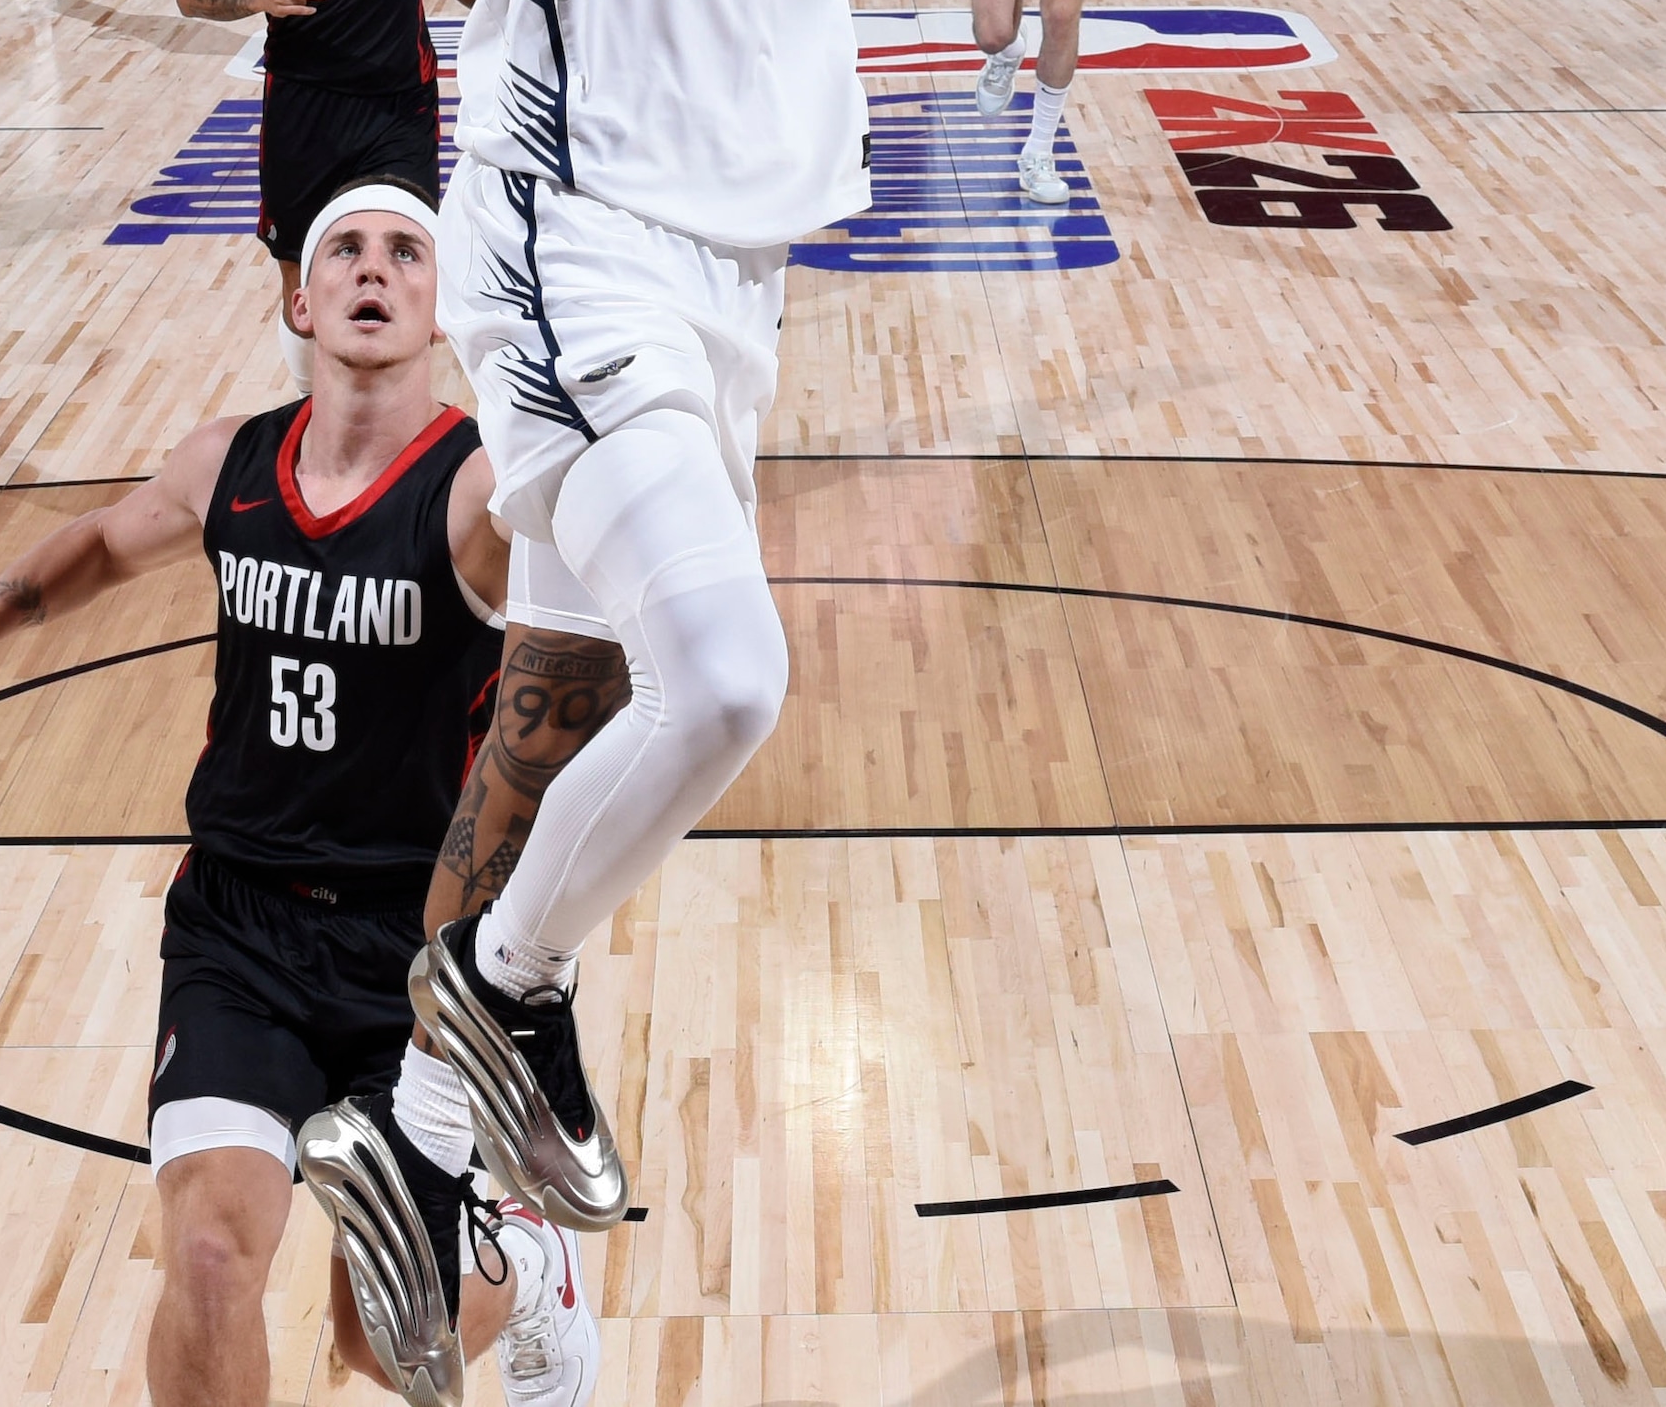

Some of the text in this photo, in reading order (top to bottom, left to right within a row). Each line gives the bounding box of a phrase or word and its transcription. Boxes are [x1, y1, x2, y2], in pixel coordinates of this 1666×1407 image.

[1143, 88, 1454, 231] 2K26
[218, 550, 423, 646] PORTLAND
[269, 654, 337, 753] 53
[513, 685, 600, 741] 90
[311, 886, 338, 904] city
